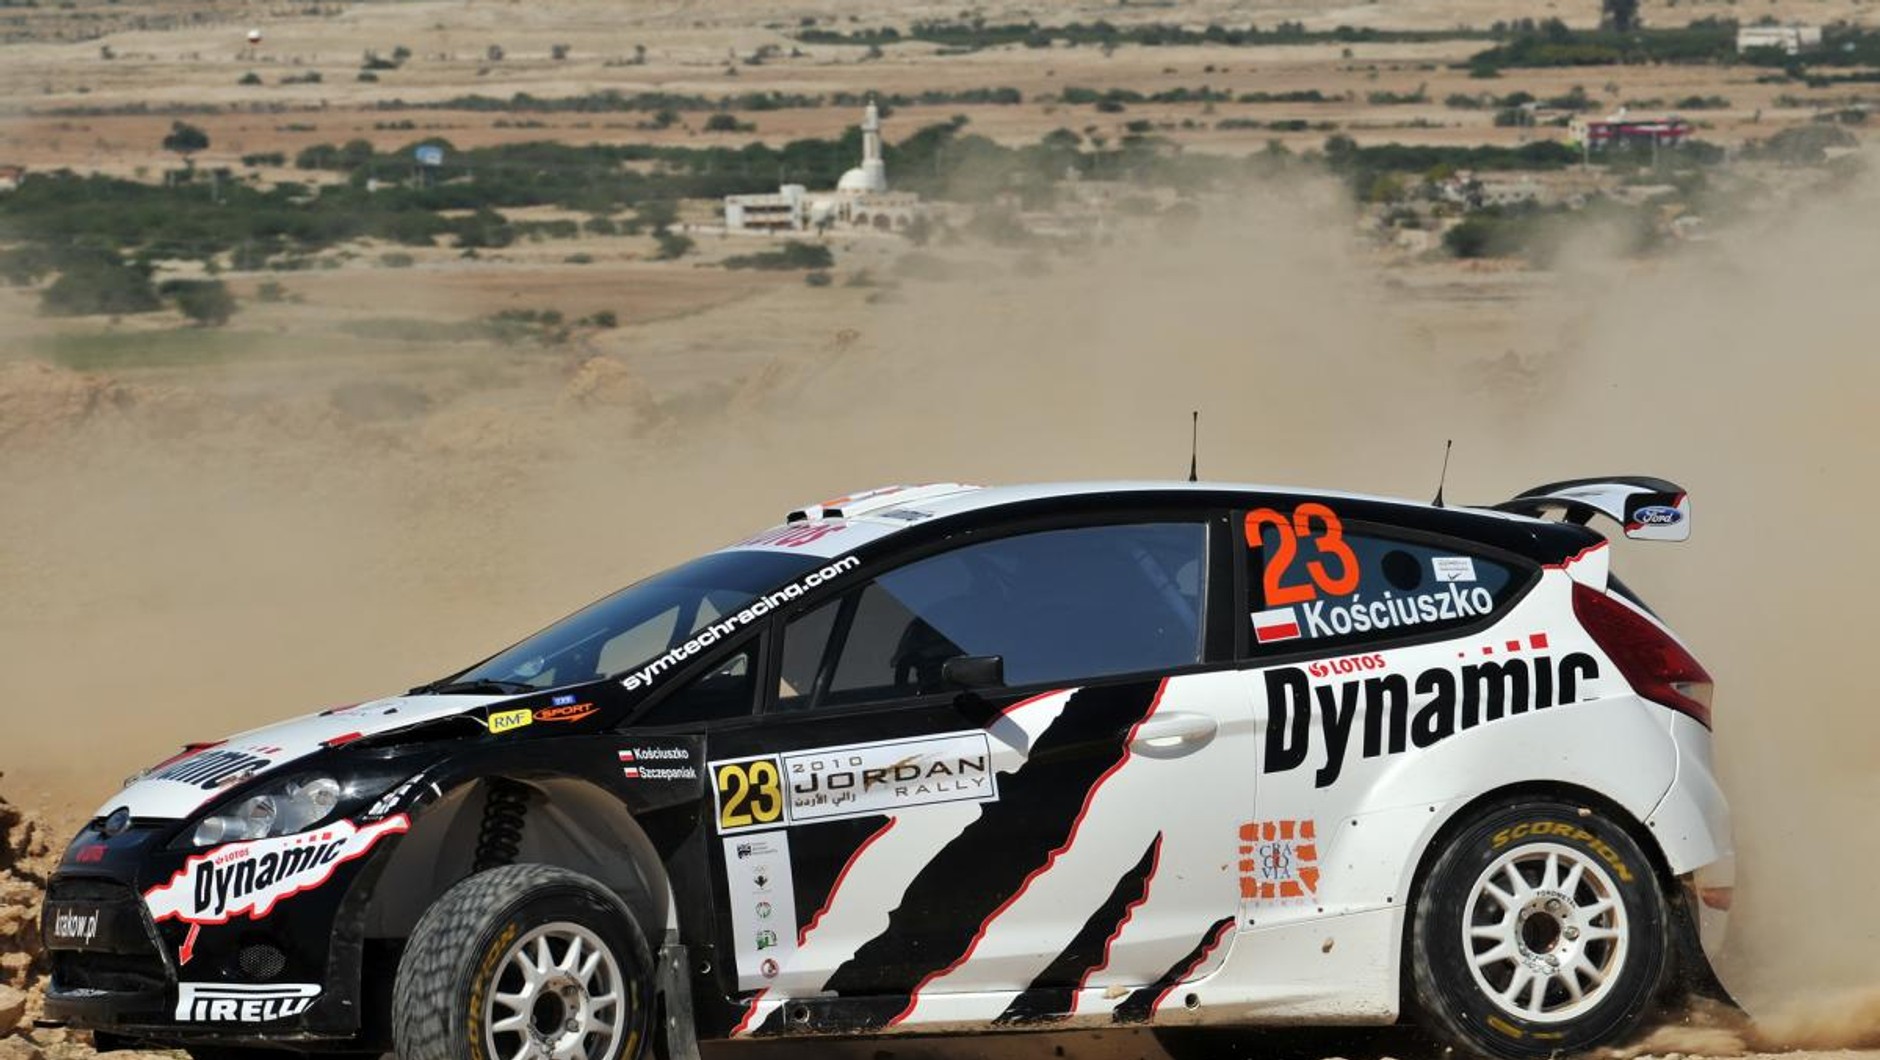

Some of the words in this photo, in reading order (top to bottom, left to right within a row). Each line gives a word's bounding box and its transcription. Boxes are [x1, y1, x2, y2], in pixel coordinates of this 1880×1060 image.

[1244, 502, 1360, 607] 23
[621, 554, 861, 692] symtechracing.com
[1302, 582, 1494, 639] Kościuszko
[1330, 653, 1386, 676] LOTOS
[494, 713, 527, 729] RMF
[542, 702, 594, 719] SPORT
[1264, 651, 1601, 789] Dynamic
[792, 756, 863, 773] 2010
[794, 756, 985, 793] JORDAN
[718, 760, 782, 828] 23
[895, 776, 985, 797] RALLY
[223, 848, 250, 863] LOTOS
[1489, 820, 1634, 883] SCORPION
[194, 837, 348, 915] Dynamic
[175, 982, 323, 1023] PIRELLI
